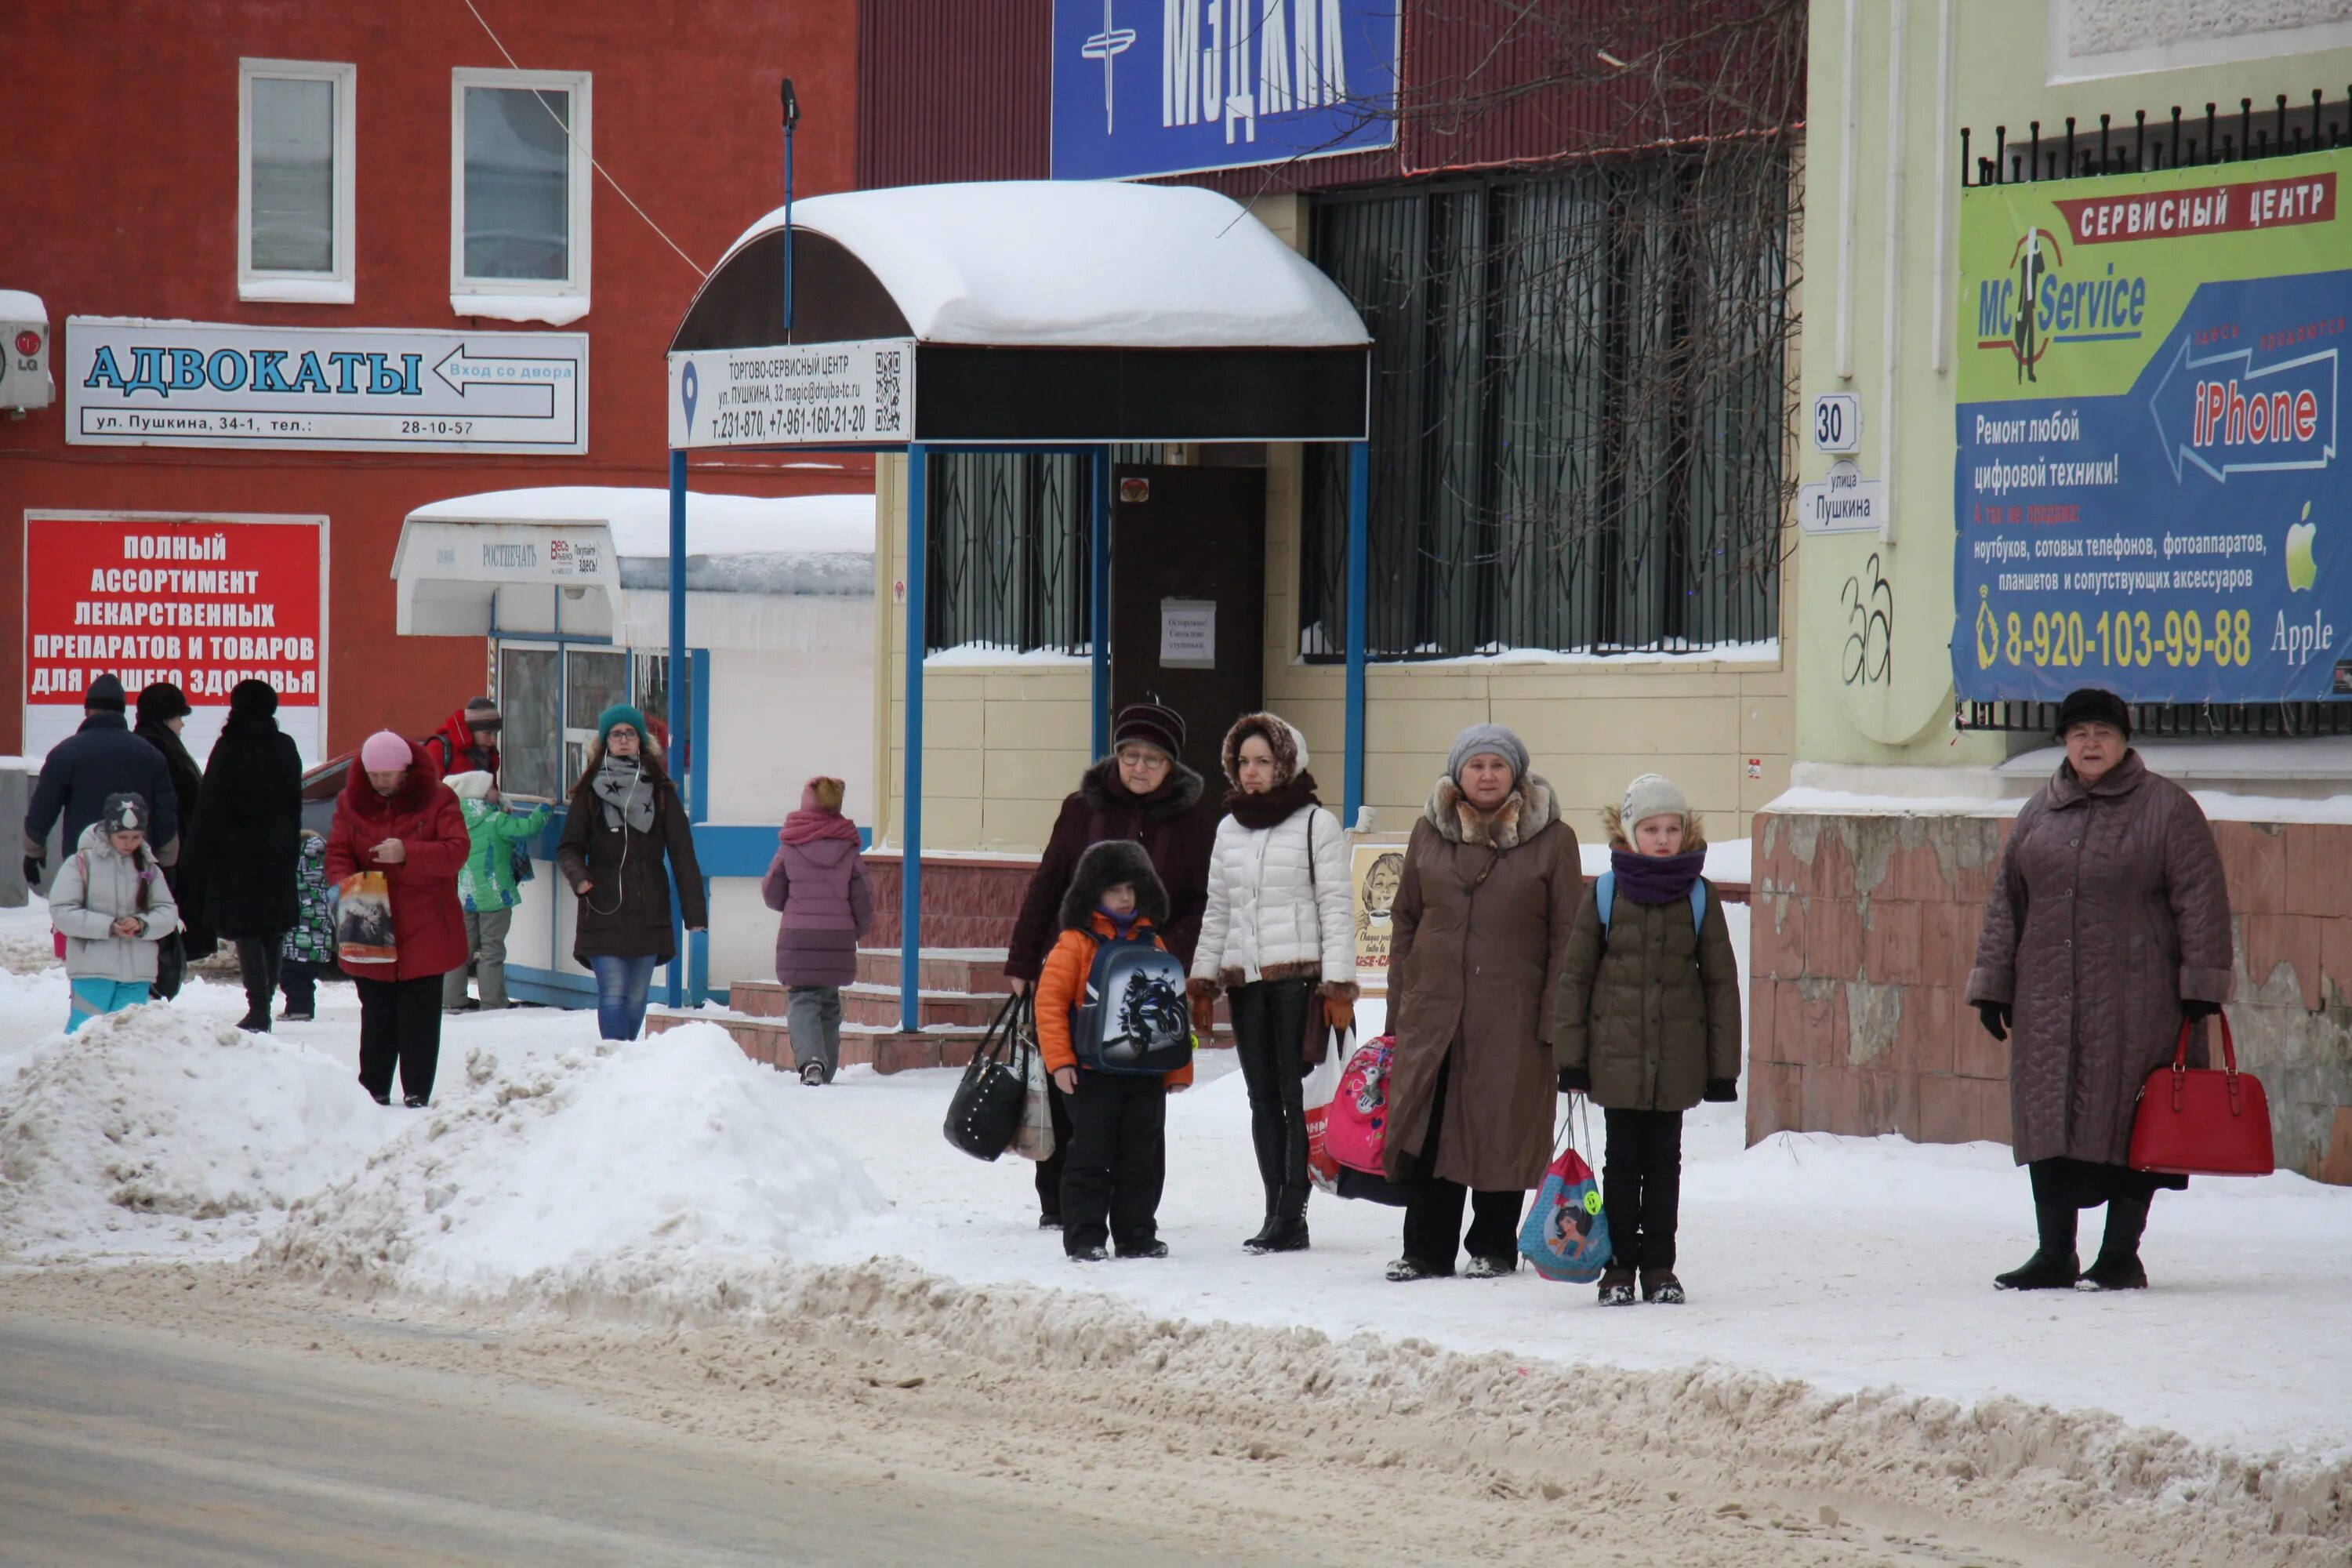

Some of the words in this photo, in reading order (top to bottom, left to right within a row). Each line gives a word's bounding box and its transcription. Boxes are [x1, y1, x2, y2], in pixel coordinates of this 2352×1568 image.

[2081, 189, 2228, 237] СЕРВИСНЫЙ
[2250, 183, 2325, 227] ЦЕНТР
[1979, 278, 2013, 337] MC
[2038, 263, 2146, 332] Service
[2259, 317, 2346, 353] продаются
[17, 358, 38, 371] LG
[84, 345, 423, 398] АДВОКАТЫ
[450, 363, 492, 378] Вход
[497, 367, 515, 377] со
[521, 367, 572, 379] двора
[729, 353, 819, 380] ТОРГОВО-СЕРВИСНЫЙ
[822, 355, 849, 377] ЦЕНТР
[718, 390, 730, 409] ул.
[731, 385, 772, 406] ПУШКИНА,
[775, 384, 783, 402] 32
[786, 382, 860, 406] magic@drujba-tc.ru
[97, 416, 122, 430] ул.
[129, 415, 212, 432] Пушкина,
[220, 417, 260, 433] 34-1,
[270, 420, 312, 431] тел.:
[401, 421, 473, 434] 28-10-57
[713, 410, 765, 441] т.231-870,
[770, 405, 866, 436] +7-961-160-21-20
[1818, 403, 1842, 443] 30
[2194, 379, 2318, 447] iPhone
[1976, 414, 2027, 445] Ремонт
[2029, 410, 2080, 443] любой
[1831, 474, 1857, 493] улица
[1975, 456, 2045, 495] цифровой
[2049, 453, 2119, 486] техники!
[1817, 495, 1871, 526] Пушкина
[1974, 502, 1982, 524] А
[1986, 505, 2002, 524] так
[2008, 505, 2022, 524] же
[2027, 504, 2081, 529] продажа:
[124, 532, 227, 561] ПОЛНЫЙ
[483, 543, 536, 568] РОСТПЕЧАТЬ
[1974, 535, 2031, 564] ноутбуков,
[2035, 539, 2084, 557] сотовых
[2085, 532, 2157, 561] телефонов,
[2163, 531, 2267, 561] фотоаппаратов,
[91, 568, 259, 594] АССОРТИМЕНТ
[1999, 572, 2059, 591] планшетов
[2064, 573, 2071, 590] и
[2074, 570, 2170, 595] сопутствующих
[2173, 568, 2252, 594] аксессуаров
[74, 601, 275, 627] ЛЕКАРСТВЕННЫХ
[34, 634, 180, 659] ПРЕПАРАТОВ
[188, 636, 203, 659] И
[210, 637, 314, 661] ТОВАРОВ
[2005, 609, 2251, 667] 8-920-103-99-88
[2270, 609, 2333, 666] Apple
[31, 668, 82, 695] ДЛЯ
